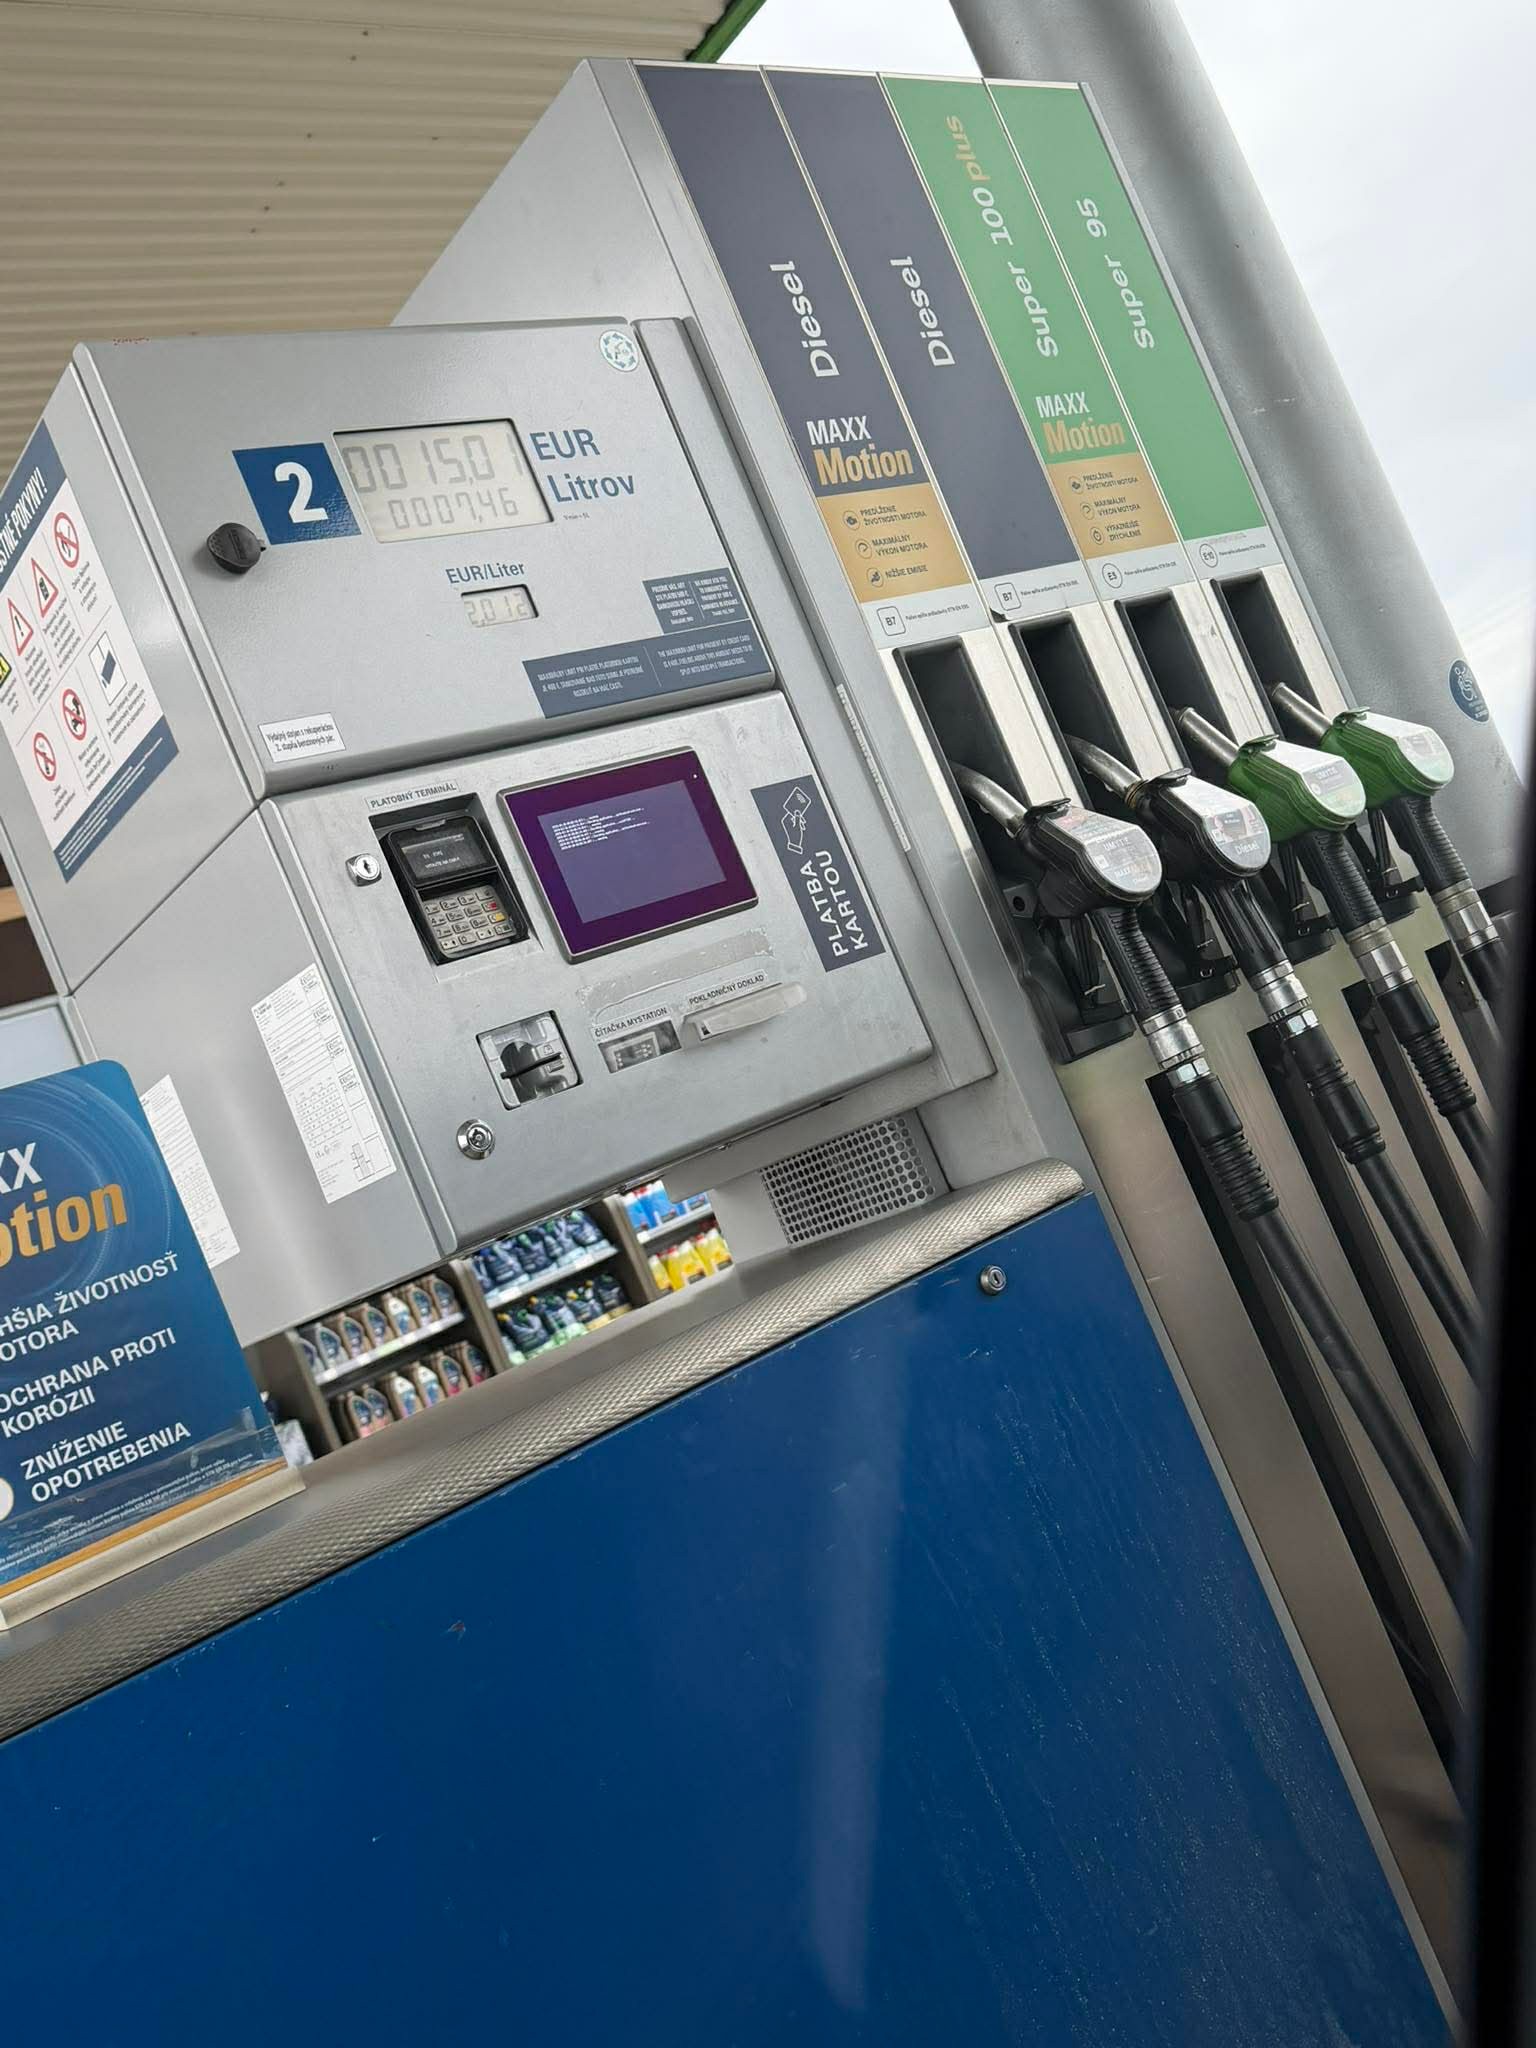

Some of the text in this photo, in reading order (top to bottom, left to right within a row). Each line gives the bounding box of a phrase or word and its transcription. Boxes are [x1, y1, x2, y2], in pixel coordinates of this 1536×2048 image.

[946, 115, 1058, 358] Super 100 plus
[1076, 198, 1155, 349] Super 95
[770, 261, 840, 377] Diesel
[890, 256, 955, 366] Diesel
[1035, 391, 1090, 418] MAXX
[529, 429, 600, 460] EUR
[806, 415, 872, 446] MAXX
[1042, 418, 1126, 454] Motion
[813, 443, 914, 486] Motion
[11, 466, 48, 539] POKYNY!
[274, 461, 329, 524] 2
[547, 473, 635, 502] Litrov
[900, 510, 927, 522] MOTORA
[900, 541, 928, 553] MOTORA
[445, 562, 525, 584] EUR/Liter
[1002, 592, 1013, 602] B7
[885, 616, 896, 627] B7
[370, 783, 457, 808] PLATOBNÝ TERMINÁL
[800, 860, 849, 957] PLATBA
[815, 850, 868, 950] KARTOU
[689, 974, 765, 1005] POKLADNIČNÝ DOKLAD
[594, 1007, 667, 1037] ČÍTAČKA MYSTATION
[54, 1250, 178, 1315] ŽIVOTNOSŤ
[0, 1327, 177, 1414] OCHRANA PROTI
[1, 1385, 96, 1438] KORÓZII
[20, 1420, 128, 1481] ZNÍŽENIE
[31, 1421, 192, 1502] OPOTREBENIA
